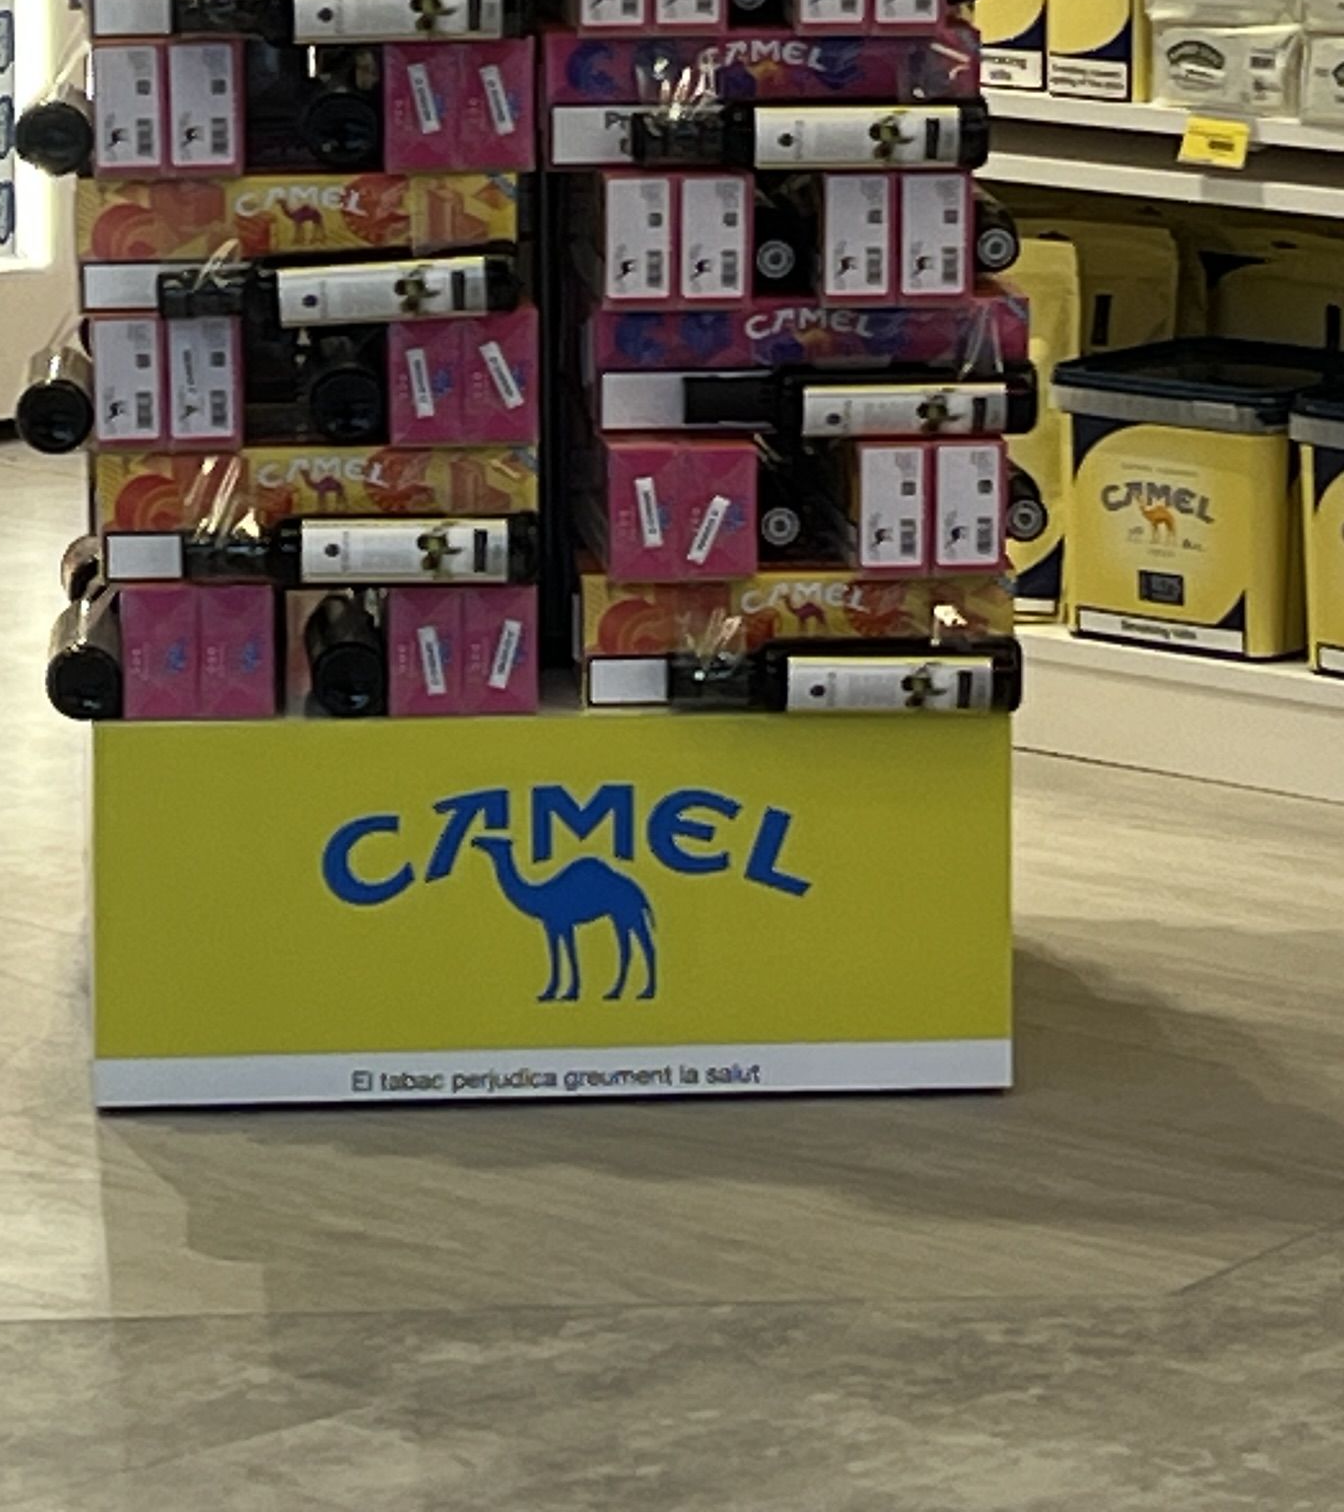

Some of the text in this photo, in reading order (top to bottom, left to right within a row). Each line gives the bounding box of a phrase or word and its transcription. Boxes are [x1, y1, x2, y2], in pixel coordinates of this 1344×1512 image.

[235, 188, 367, 218] CAMEL
[744, 306, 876, 339] CAMEL
[258, 457, 388, 487] CAMEL
[1101, 482, 1215, 524] CAMEL
[741, 582, 866, 613] CAMEL
[322, 784, 812, 906] CAMEL
[352, 1062, 761, 1095] El tabac perjudica greument la salut
